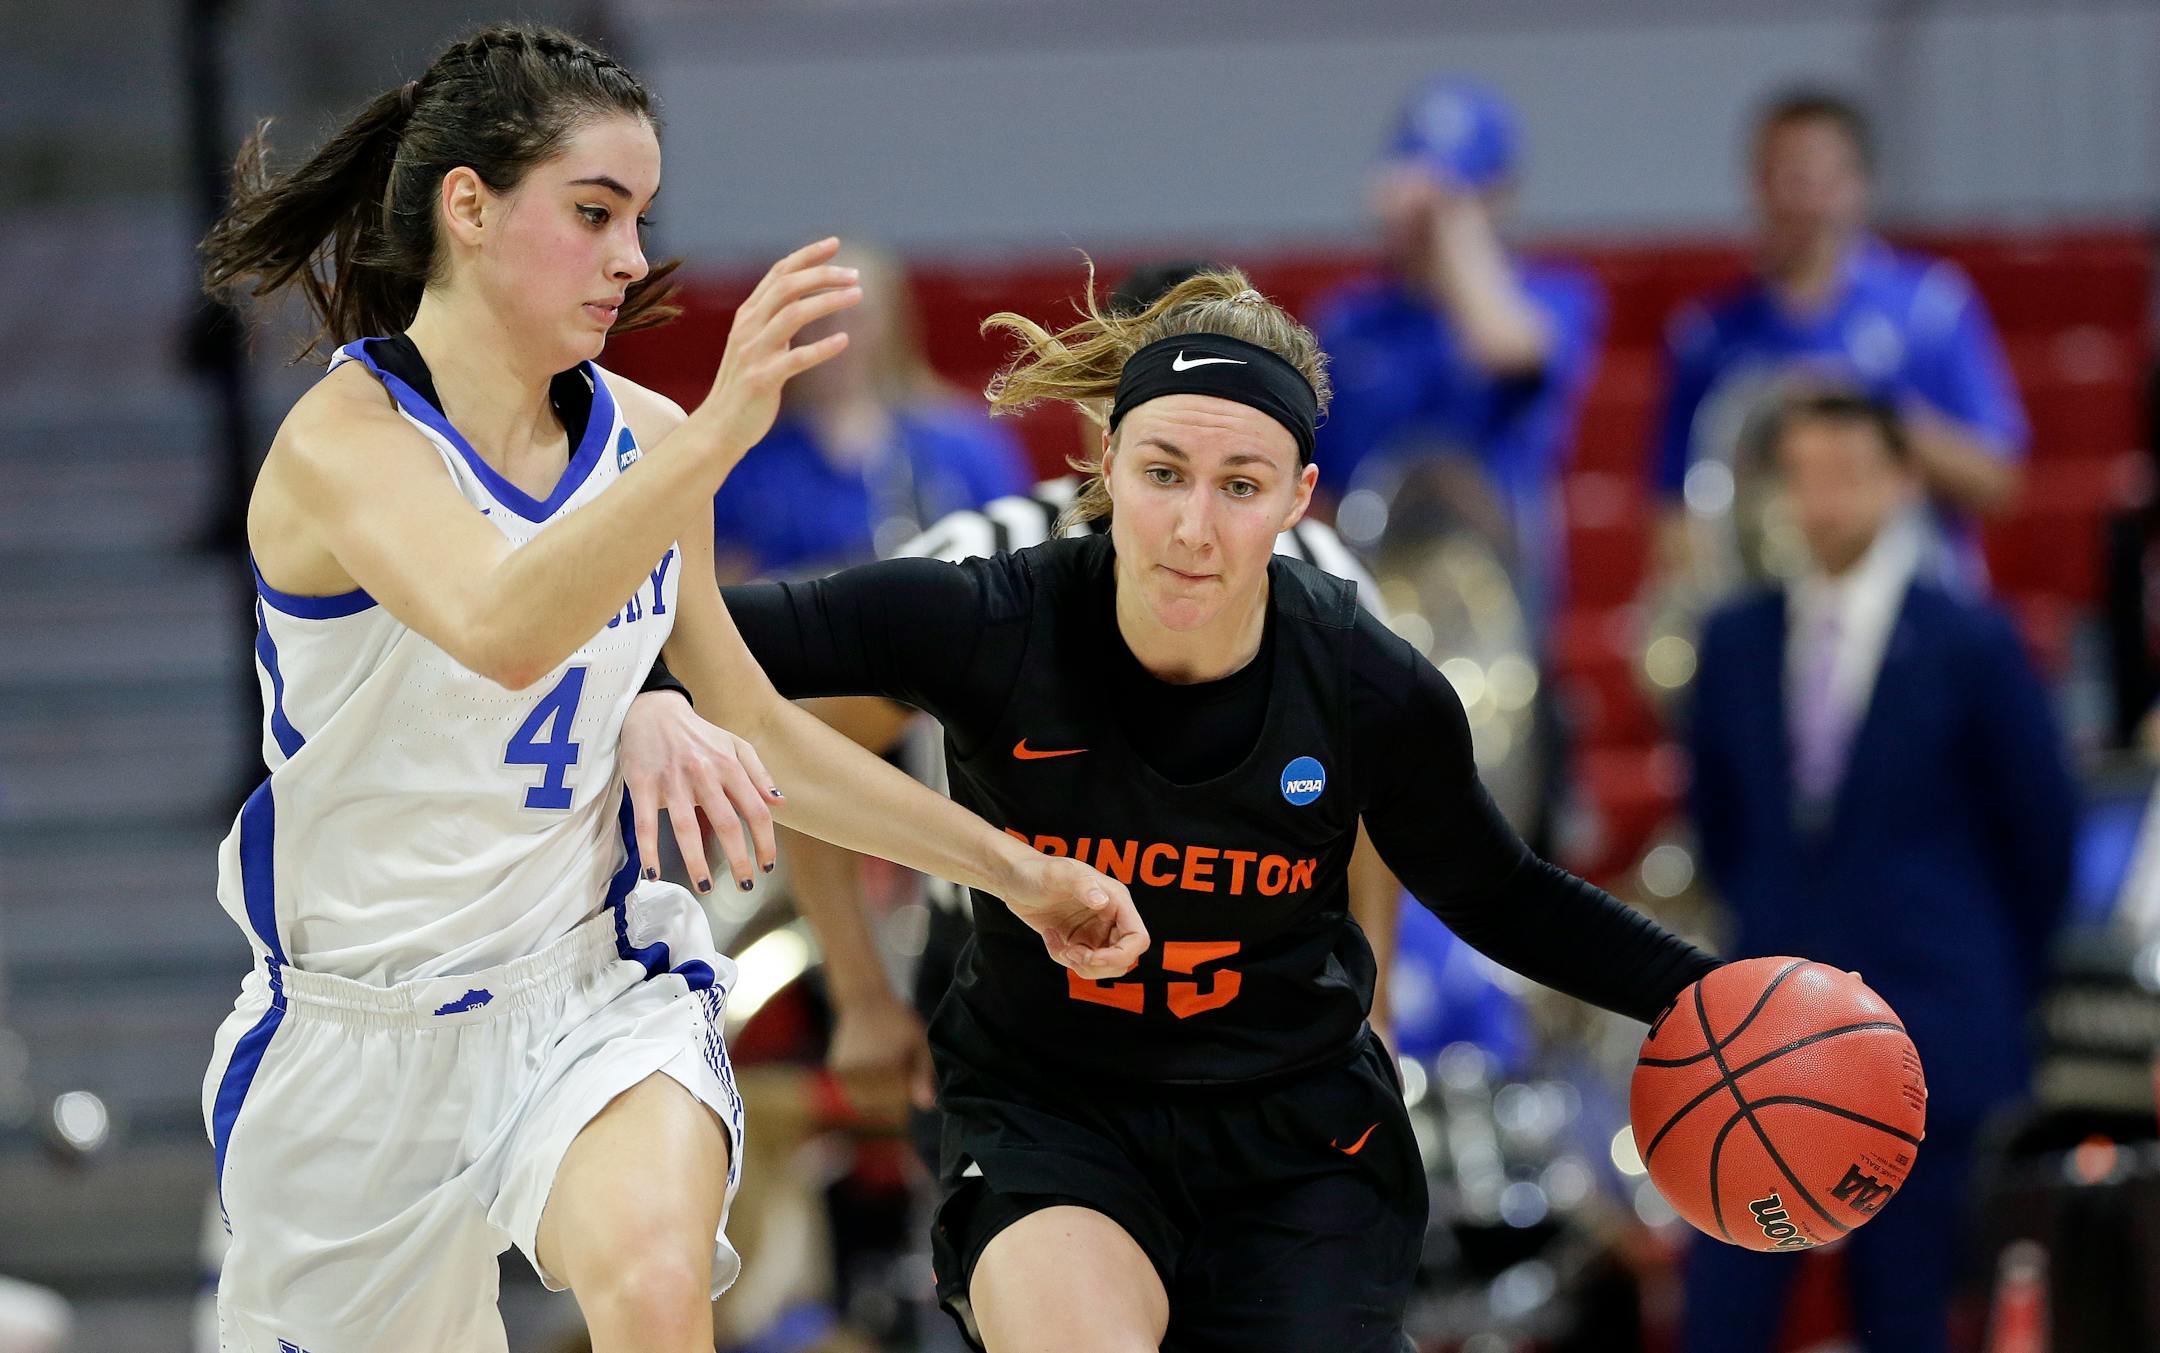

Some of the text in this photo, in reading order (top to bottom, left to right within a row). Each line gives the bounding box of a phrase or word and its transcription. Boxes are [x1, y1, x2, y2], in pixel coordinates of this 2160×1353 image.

[502, 665, 588, 811] 4
[1285, 779, 1323, 794] NCAA
[1004, 827, 1317, 896] RINCETON
